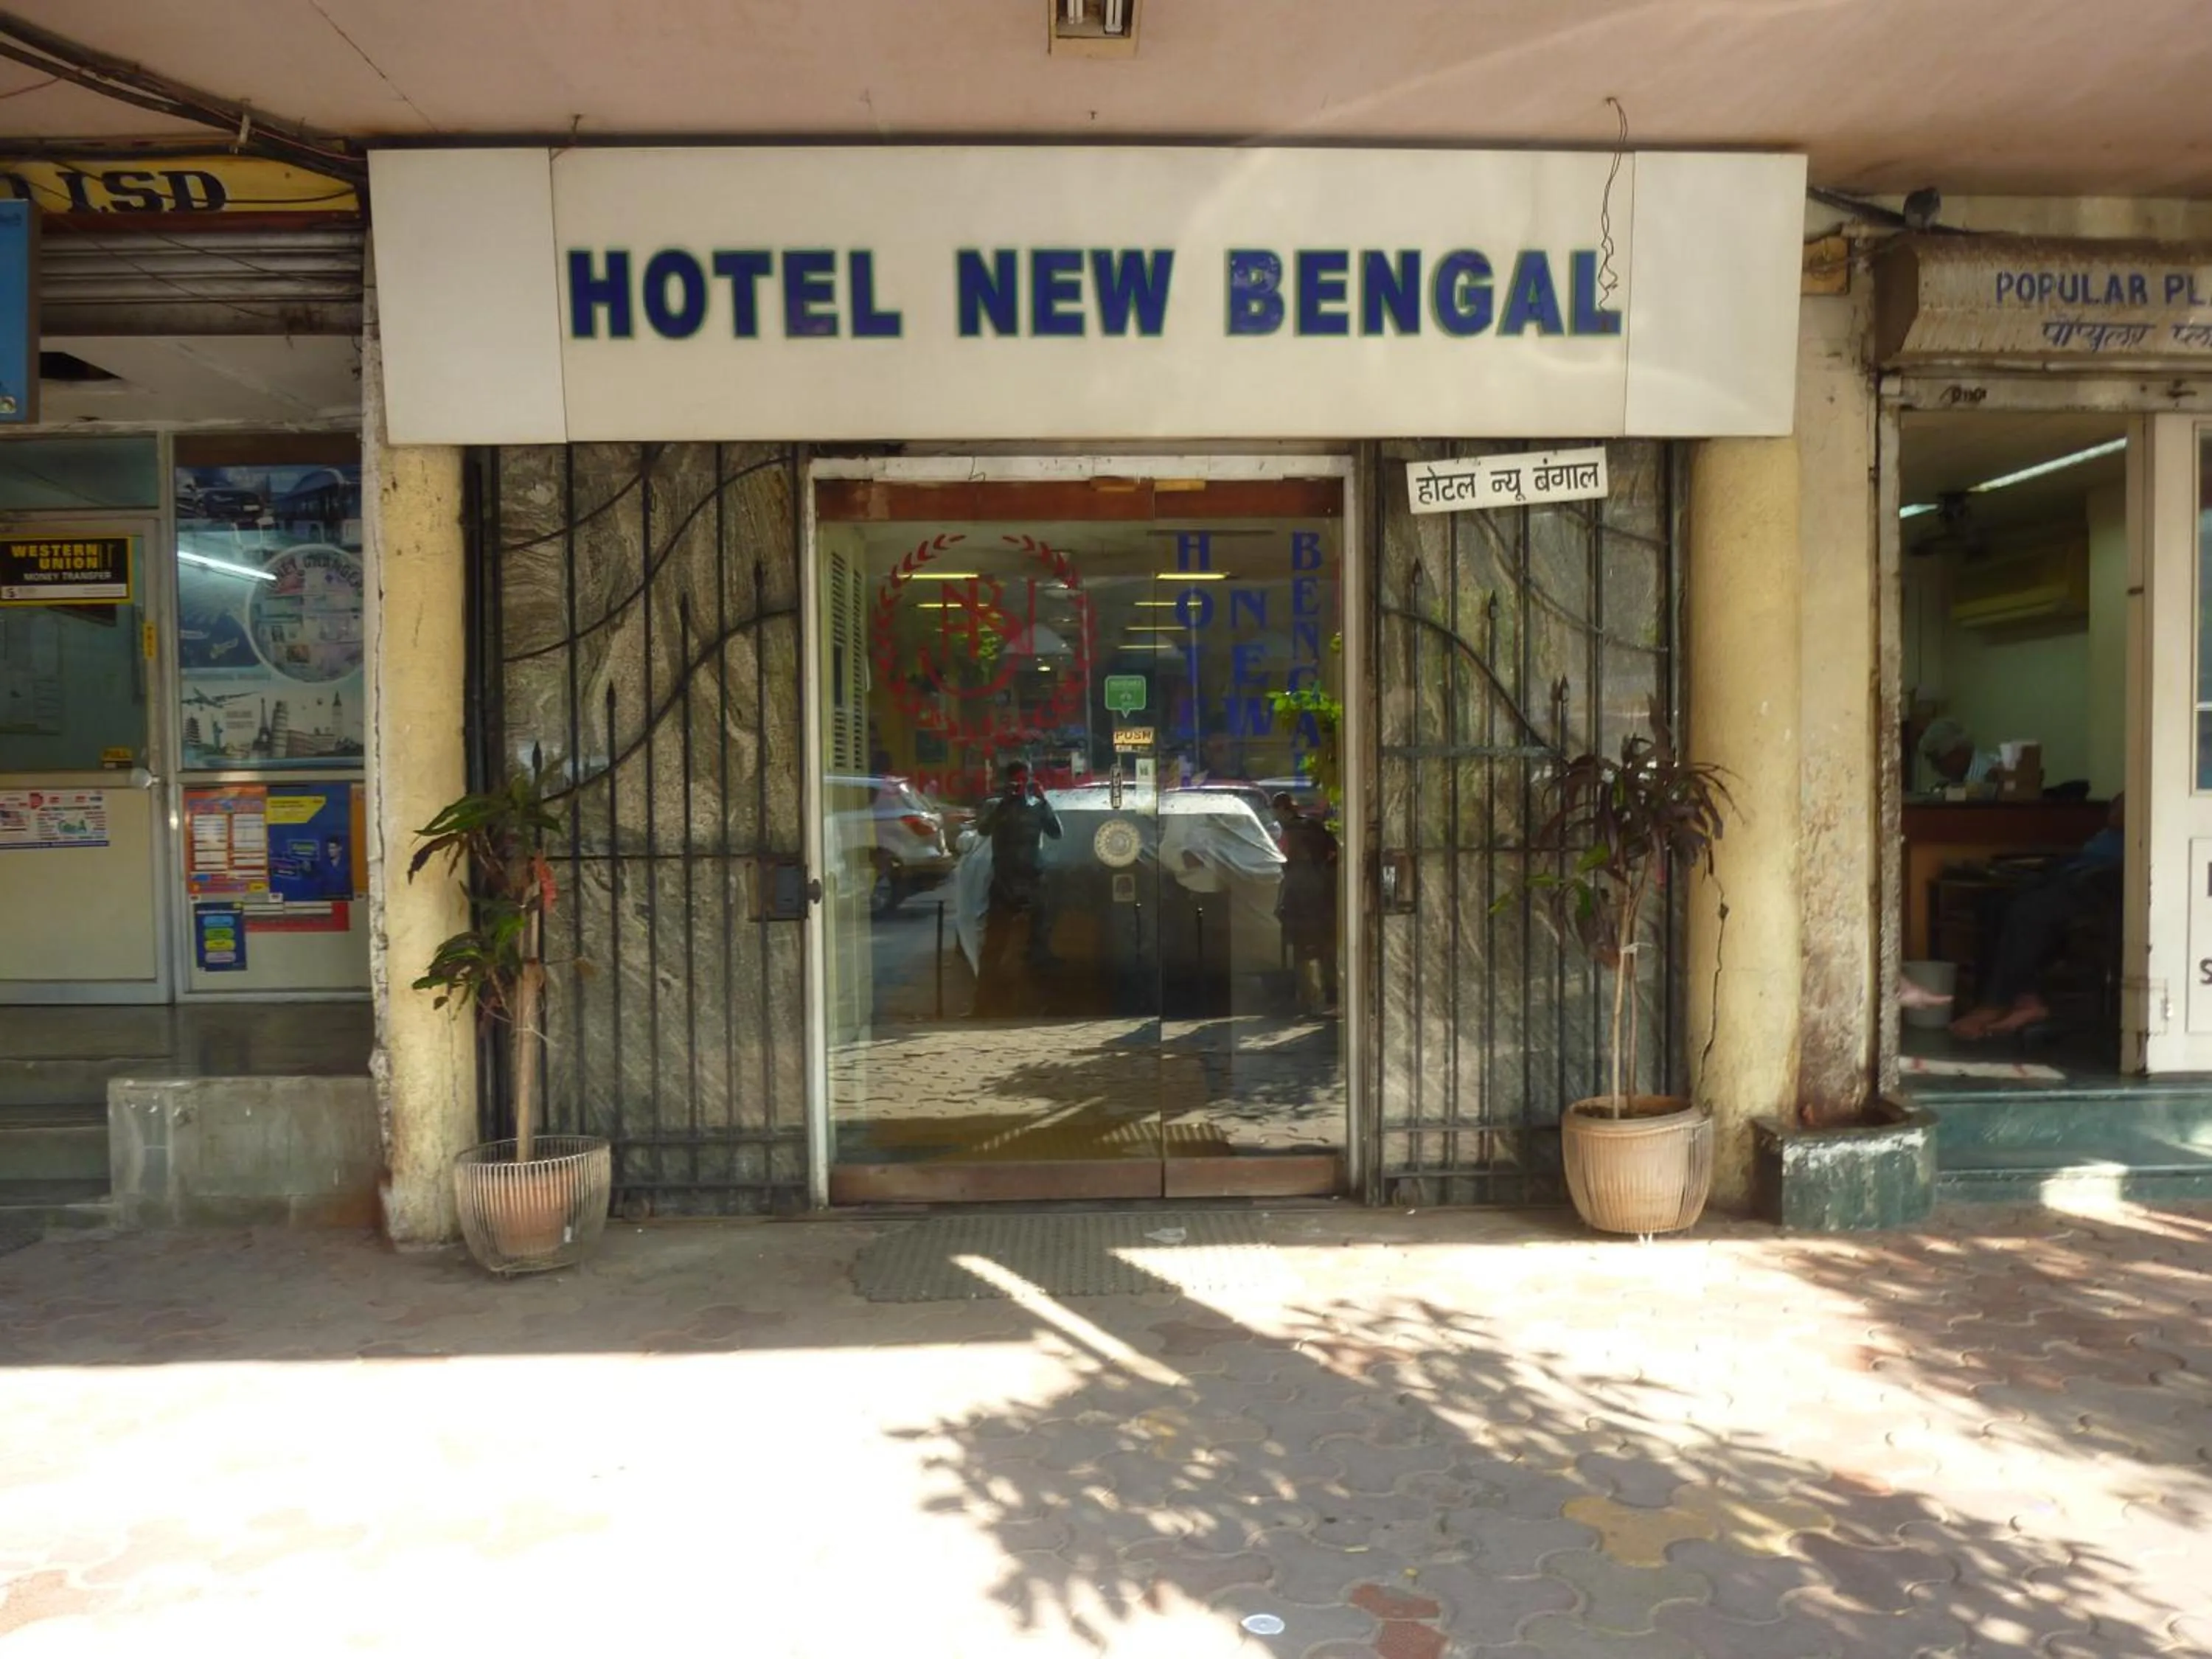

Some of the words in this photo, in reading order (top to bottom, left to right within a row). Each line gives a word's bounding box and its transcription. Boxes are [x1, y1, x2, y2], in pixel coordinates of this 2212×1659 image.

[568, 249, 902, 338] HOTEL
[956, 249, 1175, 338] NEW
[1225, 249, 1622, 337] BENGAL
[1996, 271, 2147, 306] POPULAR
[2165, 274, 2212, 307] PL
[1415, 465, 1475, 504] होटल
[1490, 468, 1526, 501] न्यू
[1533, 457, 1599, 493] बंगाल
[11, 543, 97, 557] WESTERN
[39, 557, 98, 569] UNION
